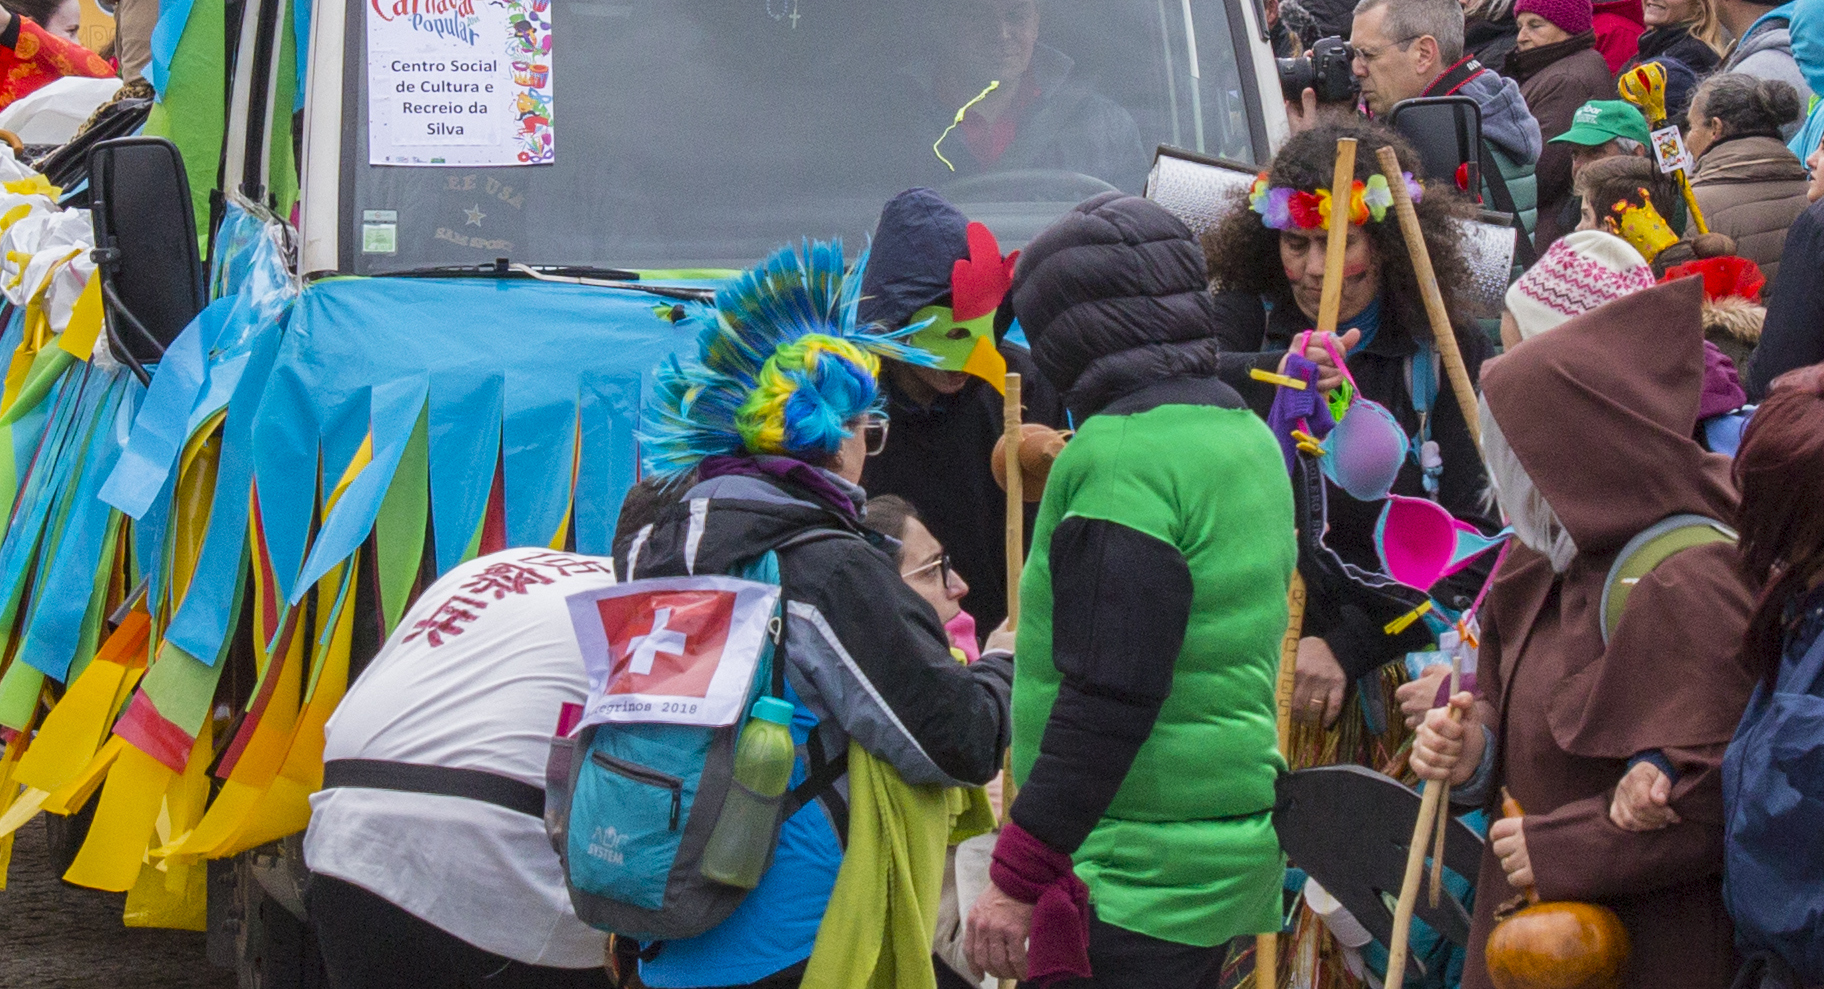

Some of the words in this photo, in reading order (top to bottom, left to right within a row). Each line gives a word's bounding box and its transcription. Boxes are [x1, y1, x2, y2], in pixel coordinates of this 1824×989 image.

[411, 10, 480, 46] Popular
[391, 60, 446, 73] Centro
[450, 59, 498, 73] Social
[395, 80, 416, 93] de
[420, 80, 480, 93] Cultura
[484, 83, 495, 93] e
[403, 101, 464, 114] Recreio
[468, 101, 489, 114] da
[426, 122, 464, 136] Silva
[662, 702, 698, 715] 2018
